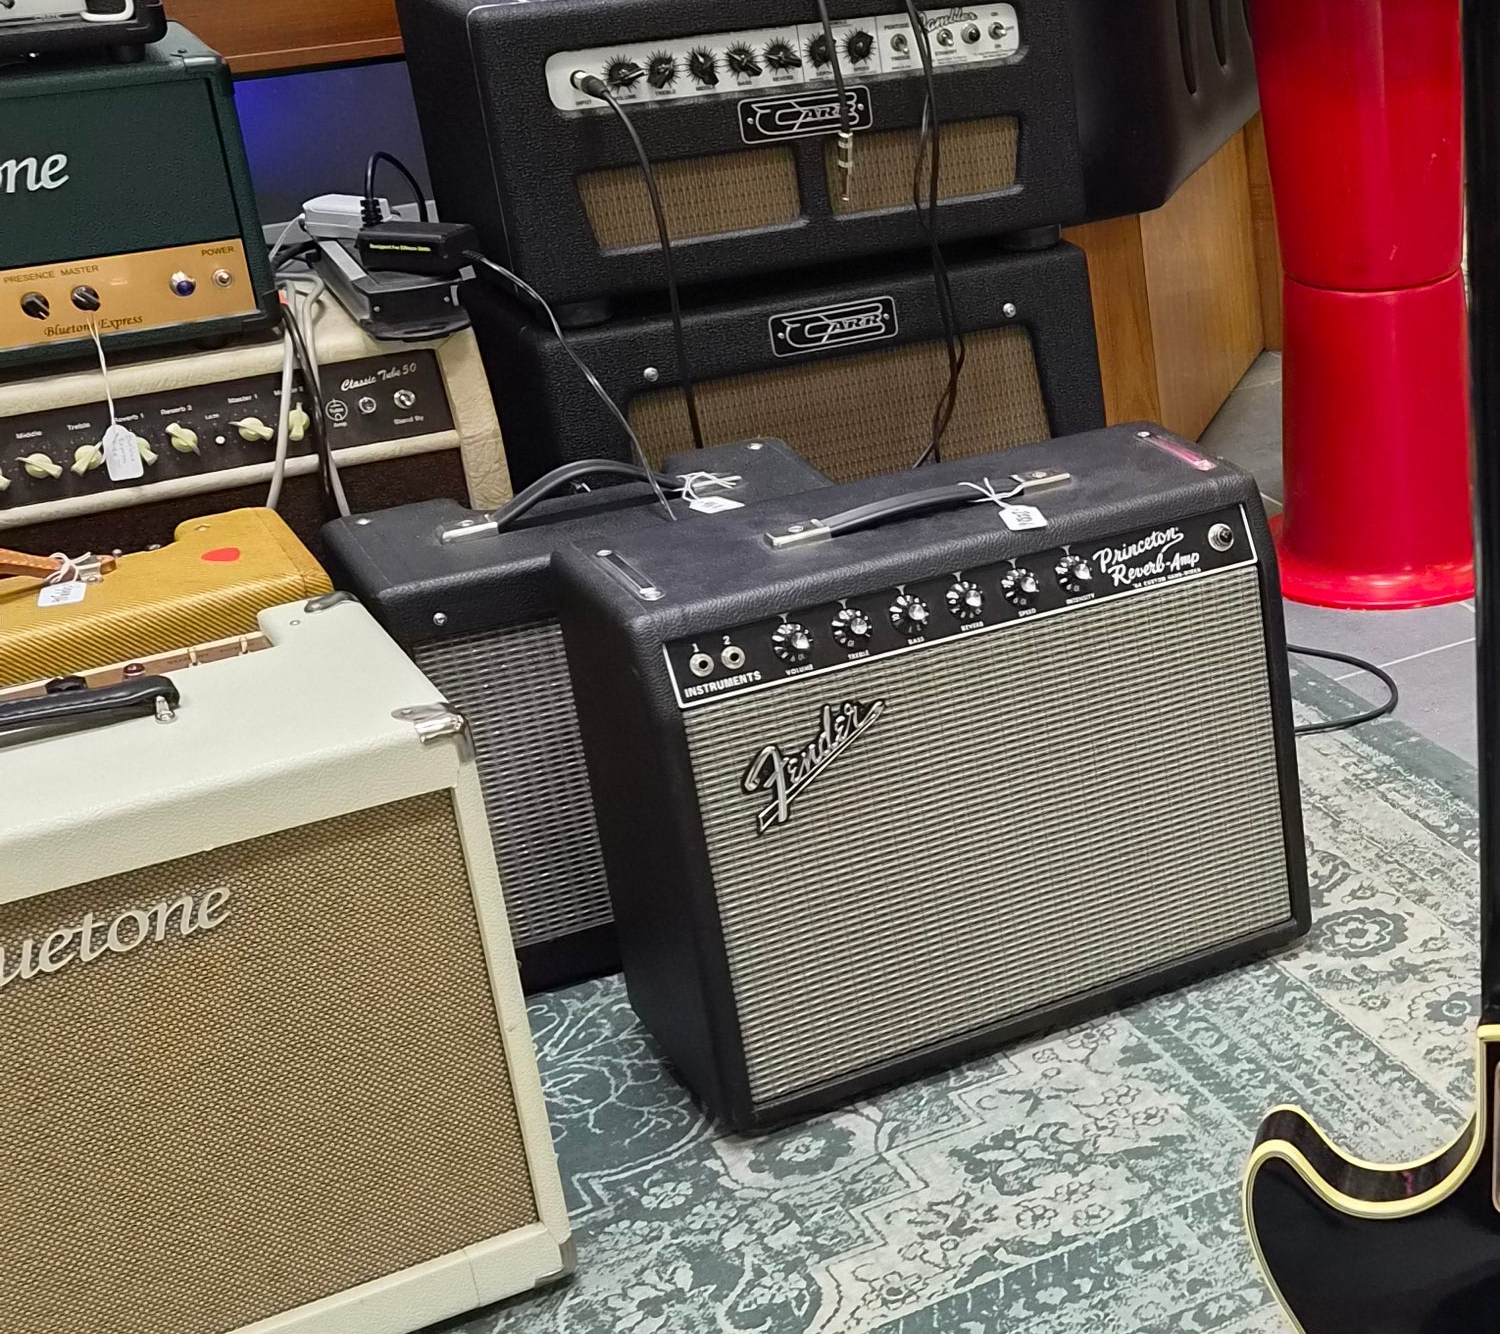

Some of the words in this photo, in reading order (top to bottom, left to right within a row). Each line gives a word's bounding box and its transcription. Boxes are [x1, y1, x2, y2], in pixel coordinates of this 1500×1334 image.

[614, 93, 637, 101] OLUME
[750, 91, 860, 136] CAR
[201, 245, 236, 257] POWER
[3, 269, 55, 283] PRESENCE
[60, 264, 99, 276] MASTER
[100, 315, 143, 332] Express
[780, 302, 886, 348] CARR
[340, 375, 377, 392] Classic
[376, 367, 402, 381] Tube
[402, 362, 417, 375] 50
[114, 413, 139, 423] everb
[67, 421, 91, 431] Treble
[16, 430, 43, 439] Middle
[1092, 526, 1185, 574] Princeton
[1107, 551, 1200, 587] Reverb-Amp
[1018, 607, 1037, 618] SPEED
[960, 620, 985, 632] REVERB
[722, 635, 732, 645] 2
[907, 635, 925, 646] BASS
[691, 643, 700, 653] 1
[847, 649, 870, 660] TREBLE
[785, 663, 814, 677] VOLUME
[684, 670, 762, 698] INSTRUMENTS
[743, 700, 885, 832] Fender
